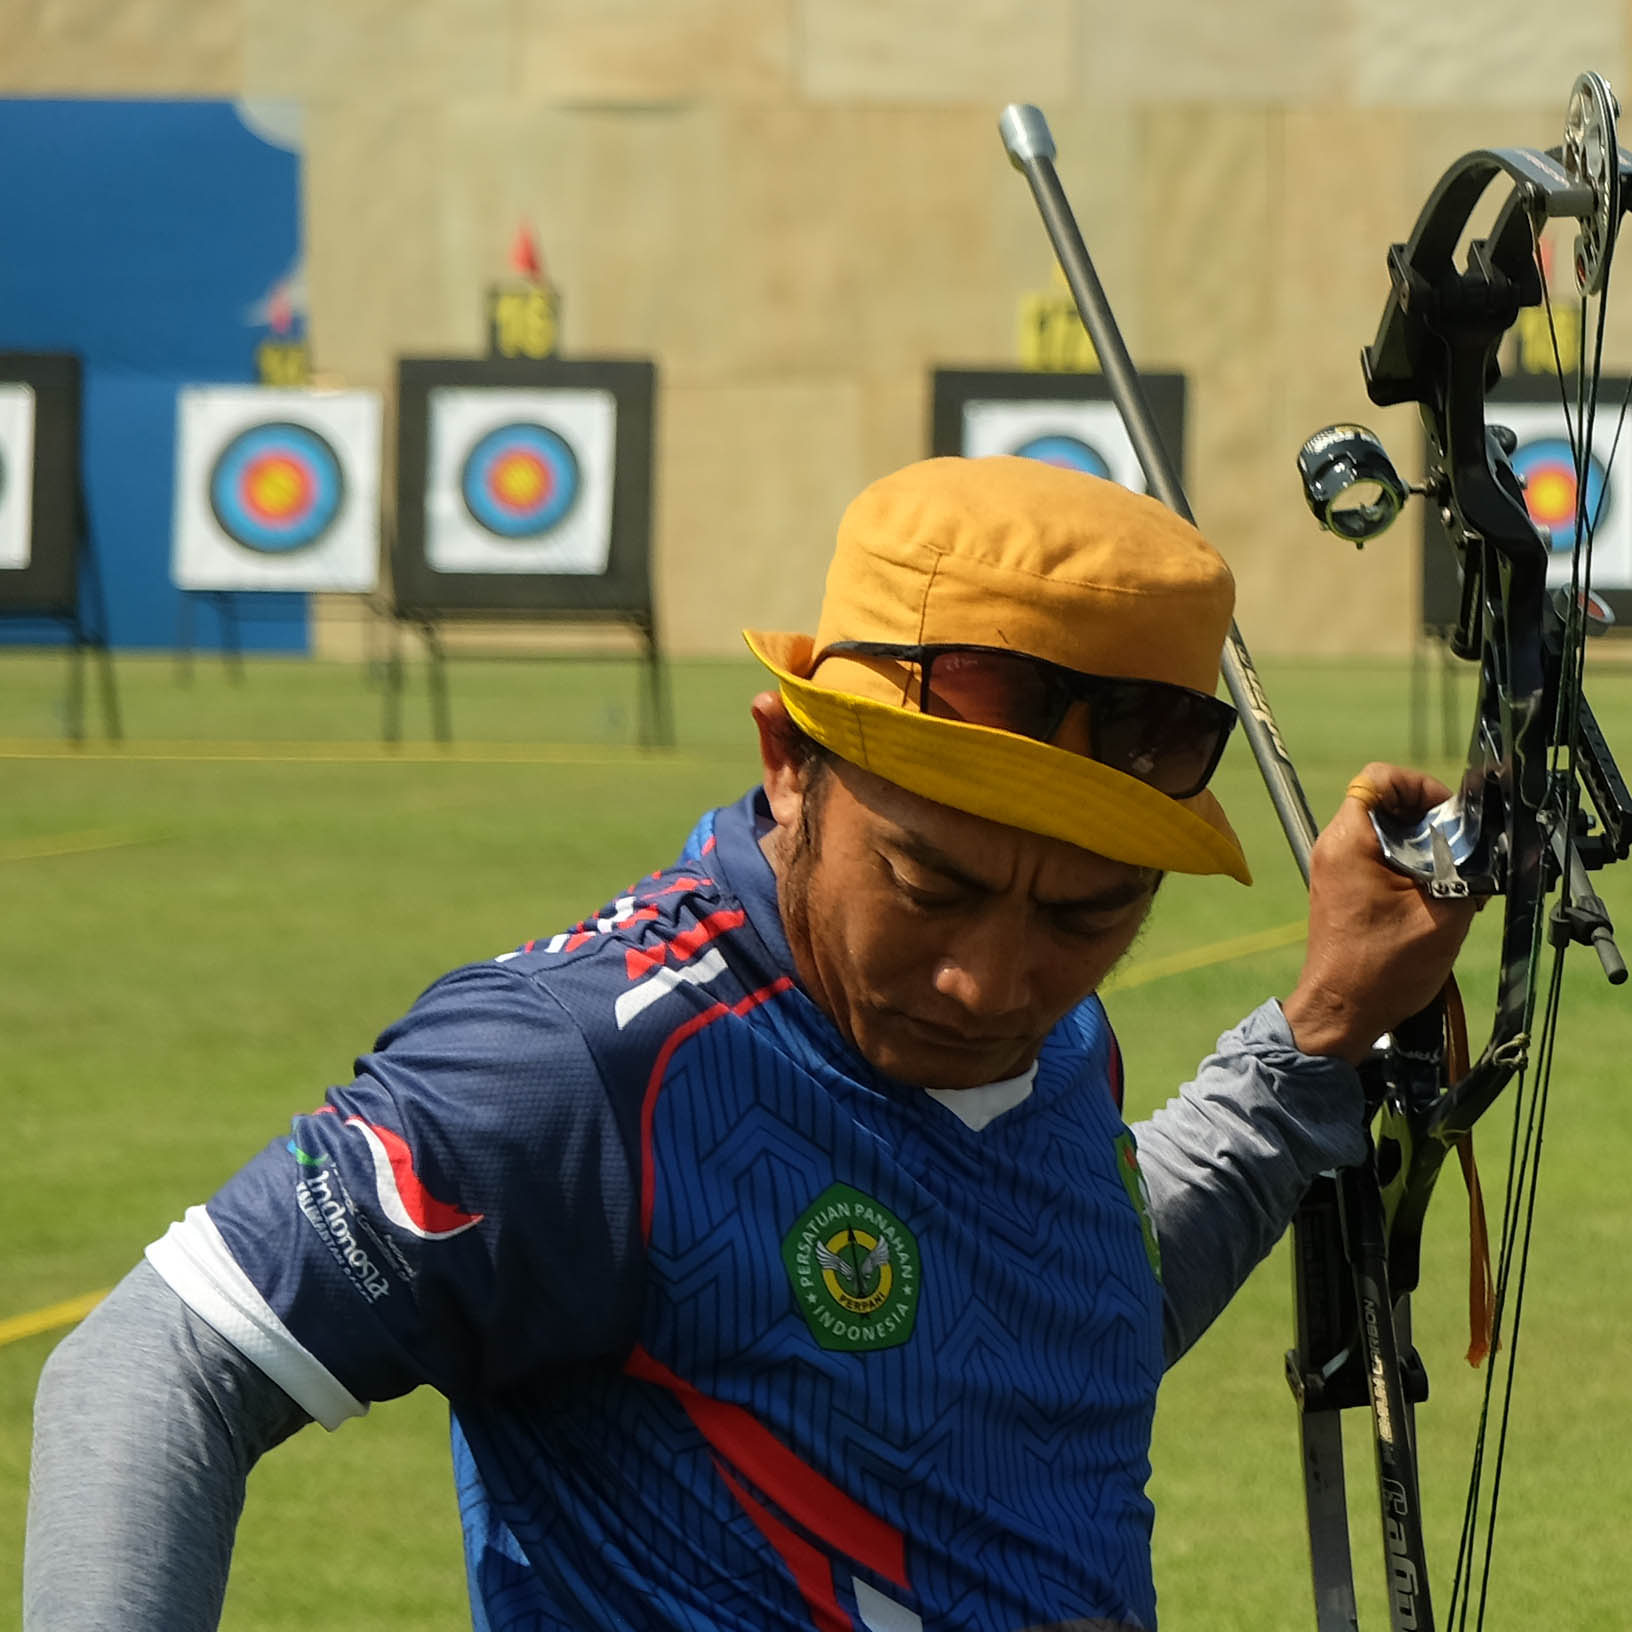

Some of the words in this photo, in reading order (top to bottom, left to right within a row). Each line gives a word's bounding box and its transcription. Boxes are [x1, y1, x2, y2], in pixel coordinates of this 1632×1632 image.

[796, 1202, 851, 1288] PERSATUAN
[854, 1203, 913, 1280] PANAHAN
[813, 1303, 910, 1342] INDONESIA
